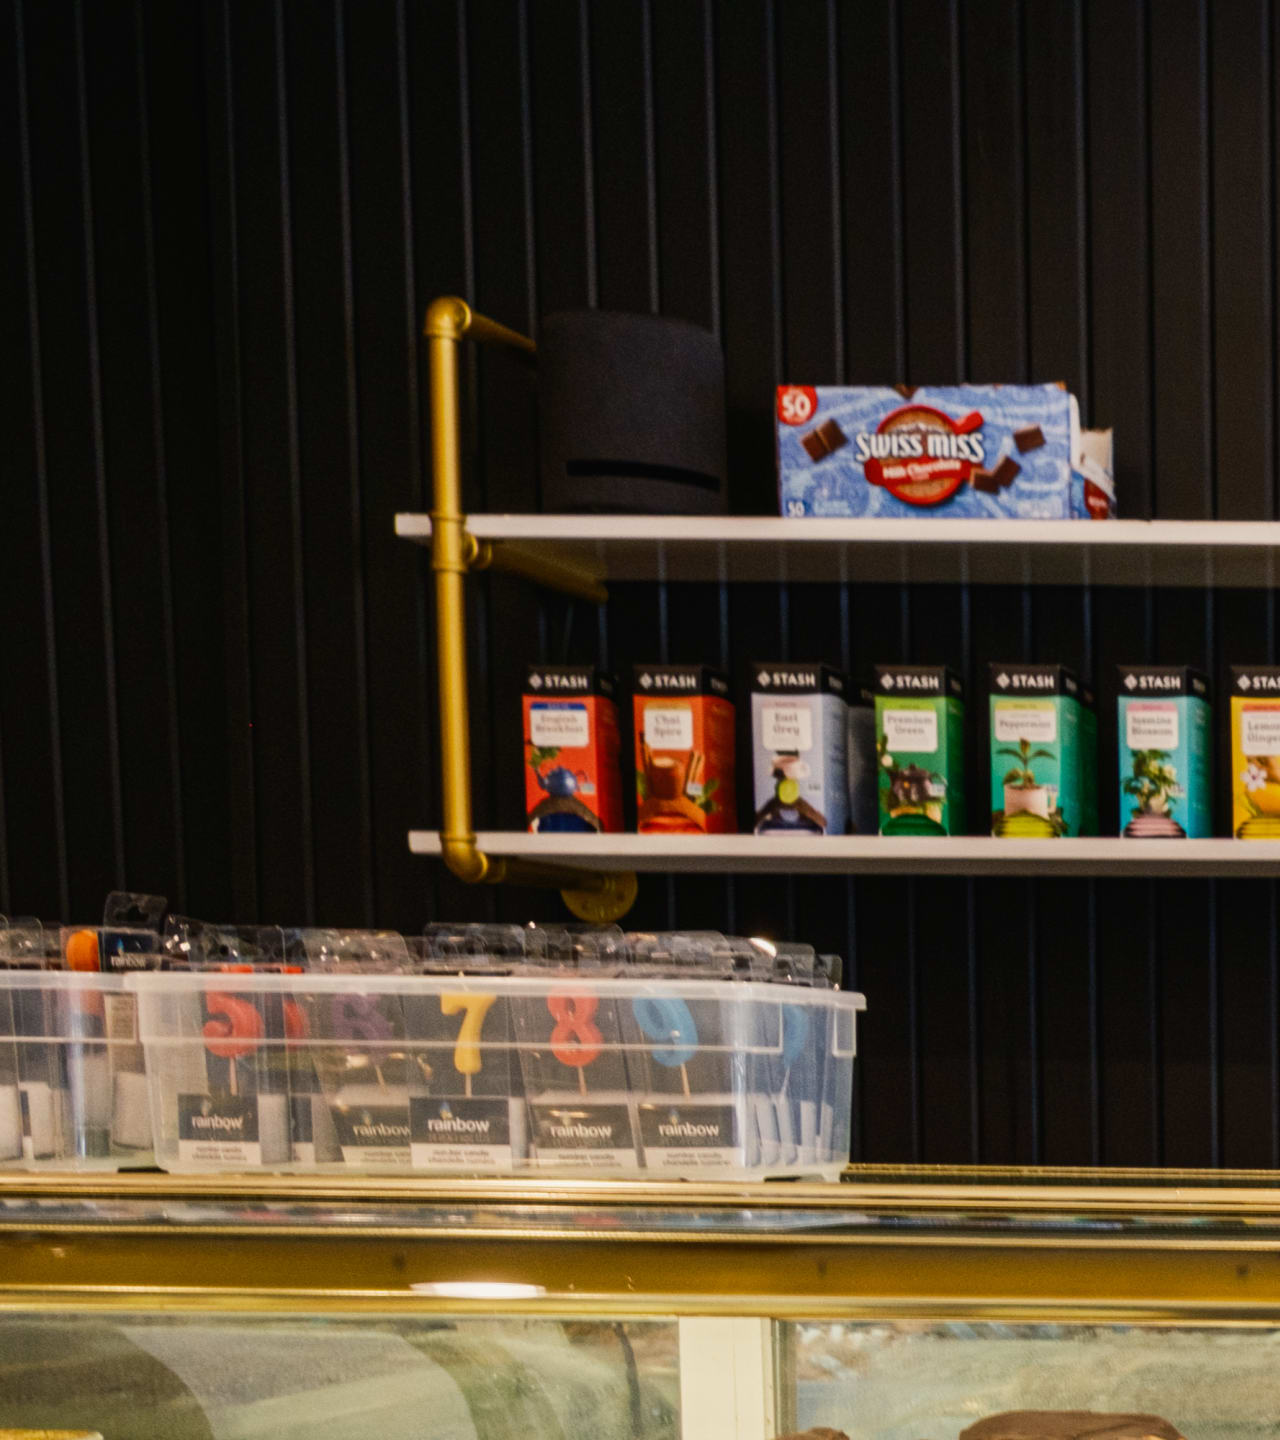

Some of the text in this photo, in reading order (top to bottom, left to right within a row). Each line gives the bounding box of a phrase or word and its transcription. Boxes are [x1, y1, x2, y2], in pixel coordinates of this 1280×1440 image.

[781, 393, 812, 418] 50
[544, 675, 588, 688] STASH
[650, 674, 697, 688] STASH
[772, 672, 816, 686] STASH
[892, 675, 939, 689] STASH
[1005, 674, 1055, 688] STASH
[1135, 675, 1181, 689] STASH
[191, 1113, 244, 1130] rainbow
[426, 1116, 490, 1135] rainbow
[548, 1120, 612, 1138] rainbow
[658, 1120, 720, 1138] rainbow
